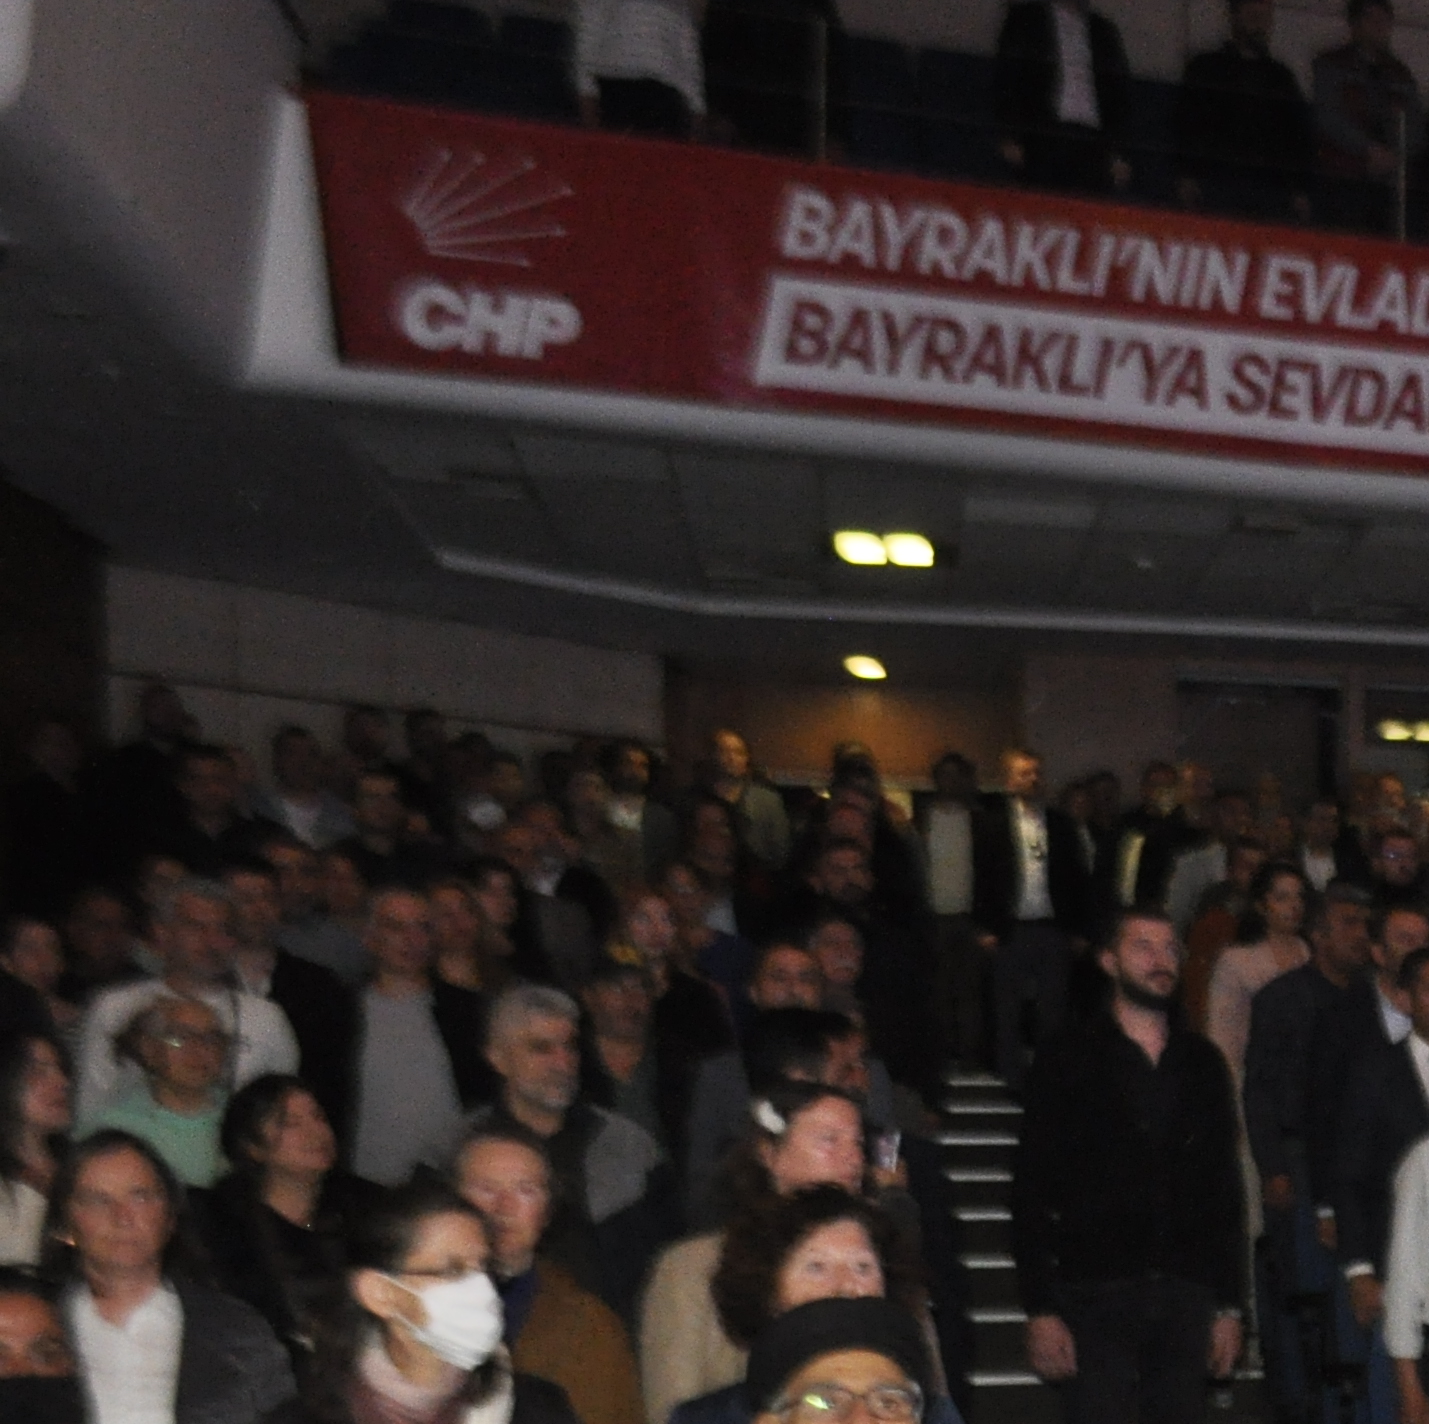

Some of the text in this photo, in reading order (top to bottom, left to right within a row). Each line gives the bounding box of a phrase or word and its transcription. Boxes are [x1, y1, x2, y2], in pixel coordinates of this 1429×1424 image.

[780, 186, 1250, 315] BAYRAKLI'NIN
[402, 281, 584, 361] CHP
[784, 300, 1210, 412] BAYRAKLI'YA
